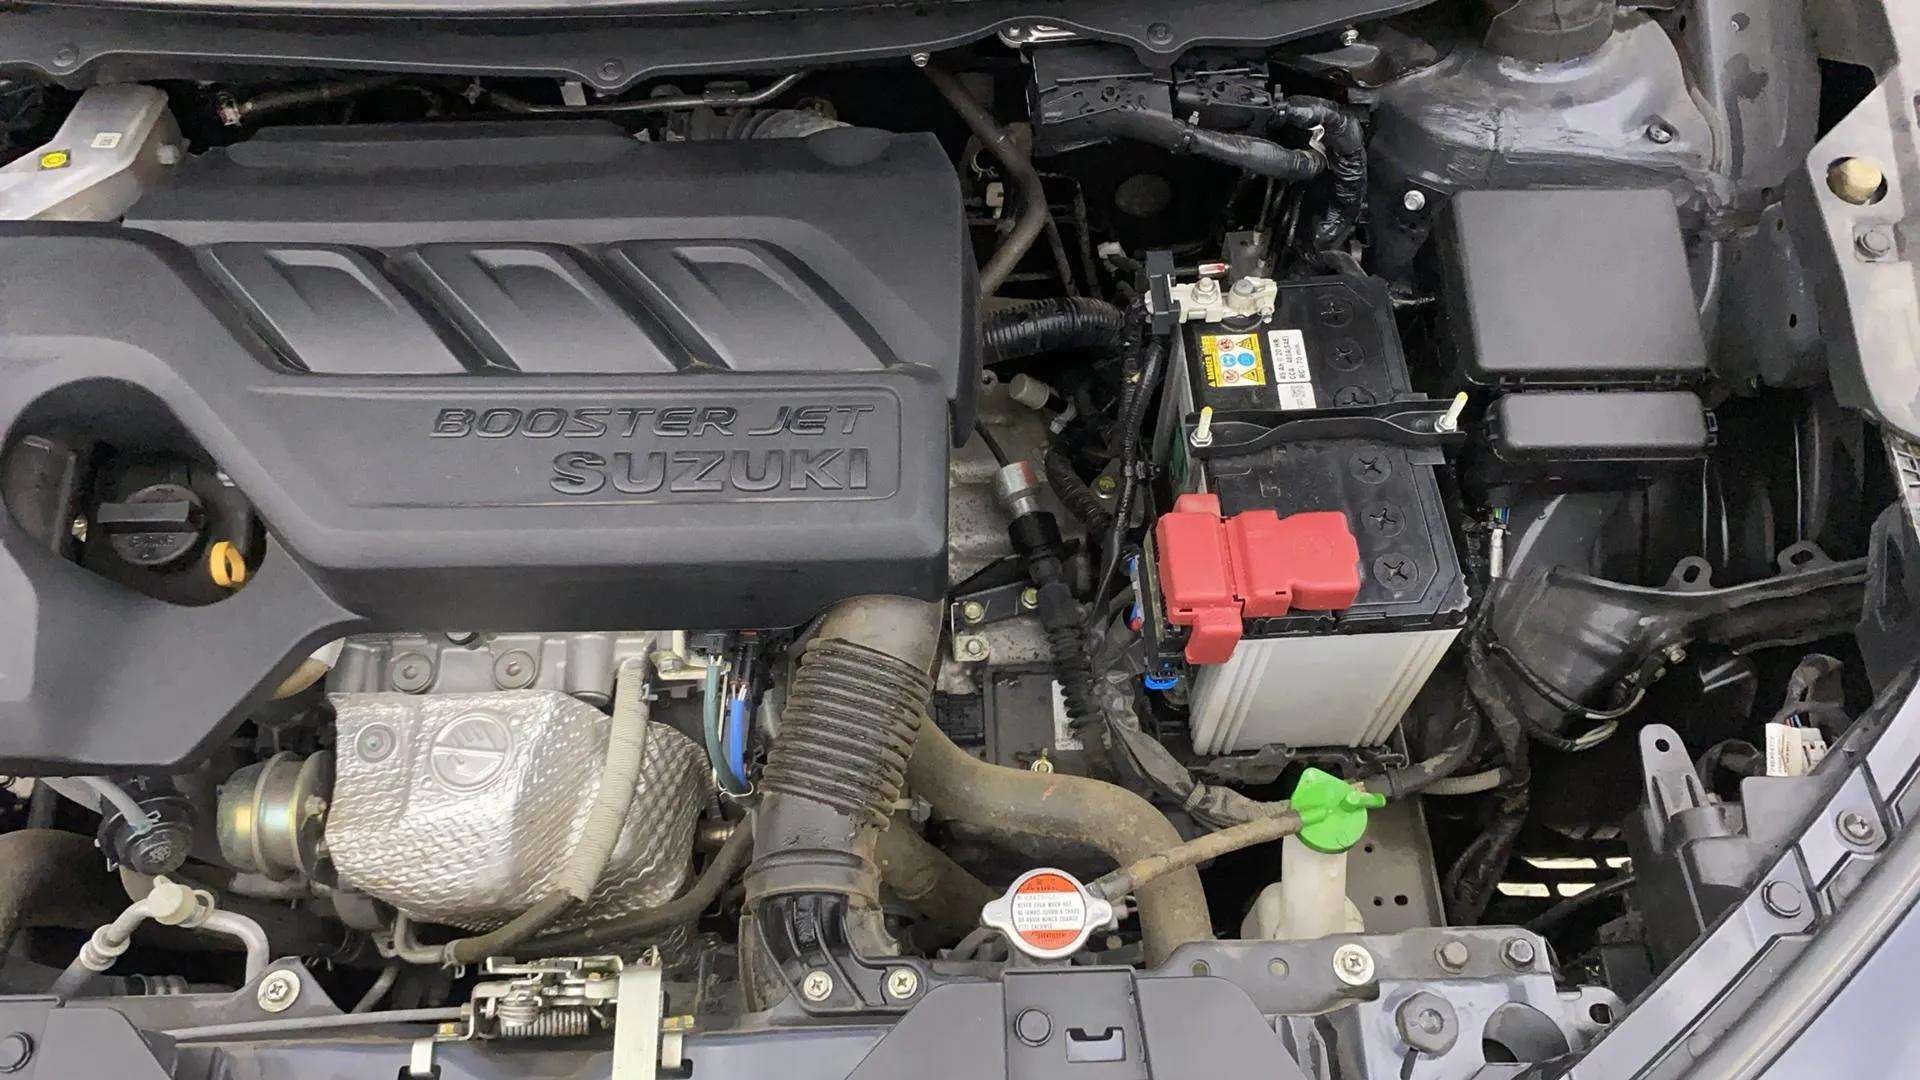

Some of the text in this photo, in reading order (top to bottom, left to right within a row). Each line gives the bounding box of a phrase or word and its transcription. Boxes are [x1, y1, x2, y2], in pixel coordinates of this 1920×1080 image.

[429, 404, 875, 438] BOOSTER JET
[551, 449, 869, 494] SUZUKI
